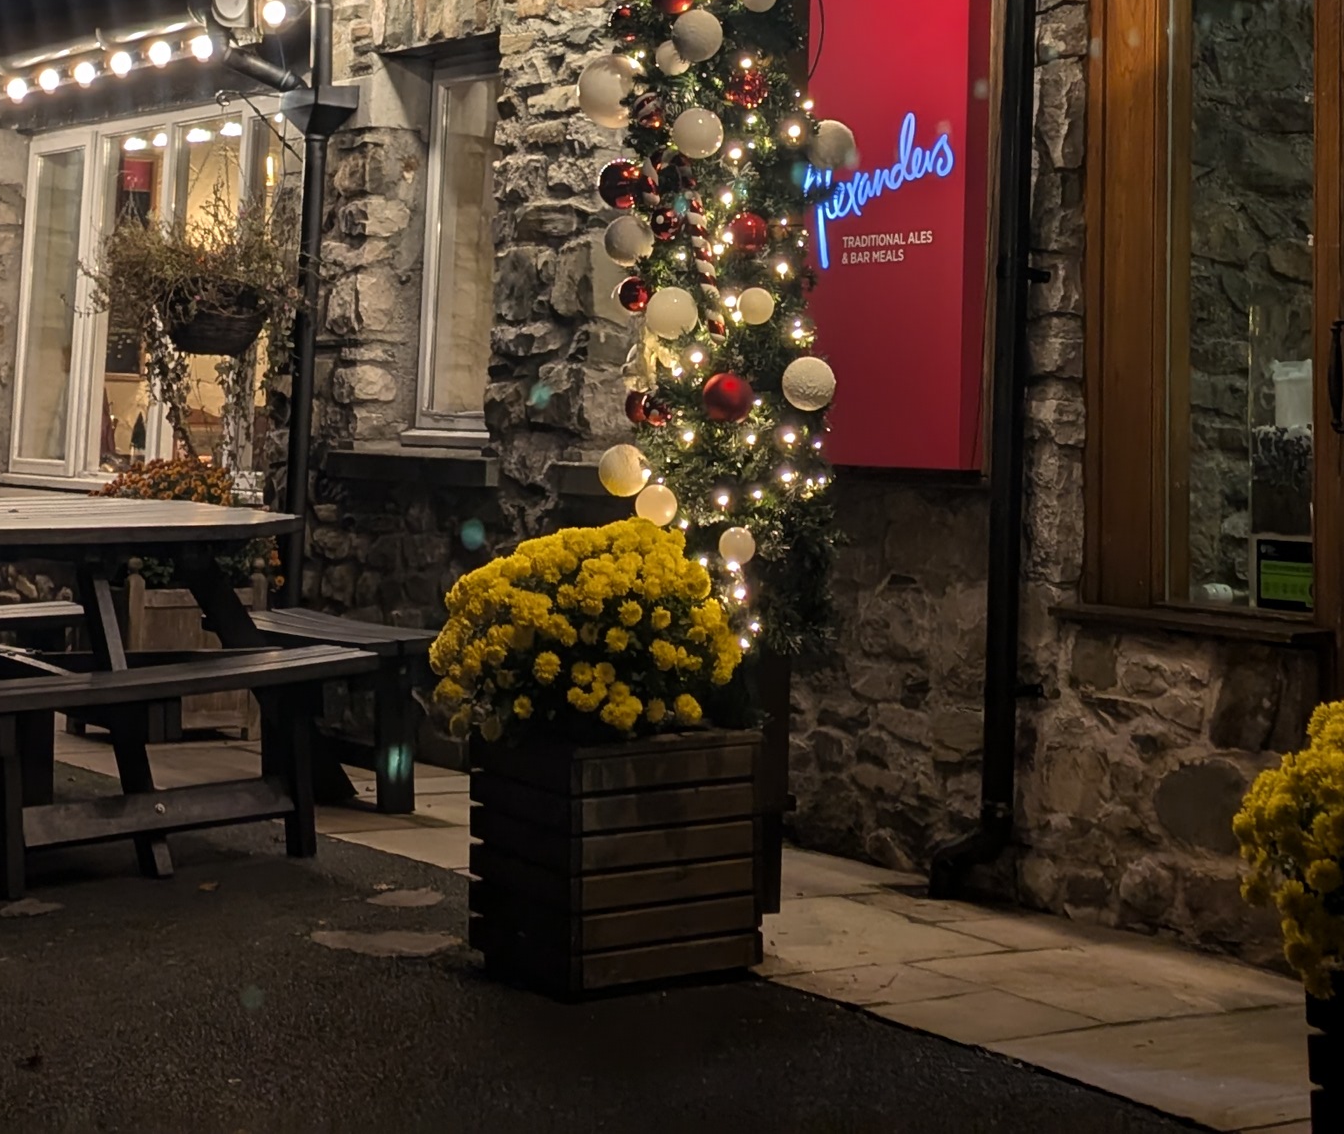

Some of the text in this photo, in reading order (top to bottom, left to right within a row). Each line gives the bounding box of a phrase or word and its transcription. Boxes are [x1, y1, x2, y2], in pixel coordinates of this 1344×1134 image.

[842, 230, 933, 248] TRADITIONAL ALES
[841, 249, 905, 265] & BAR MEALS
